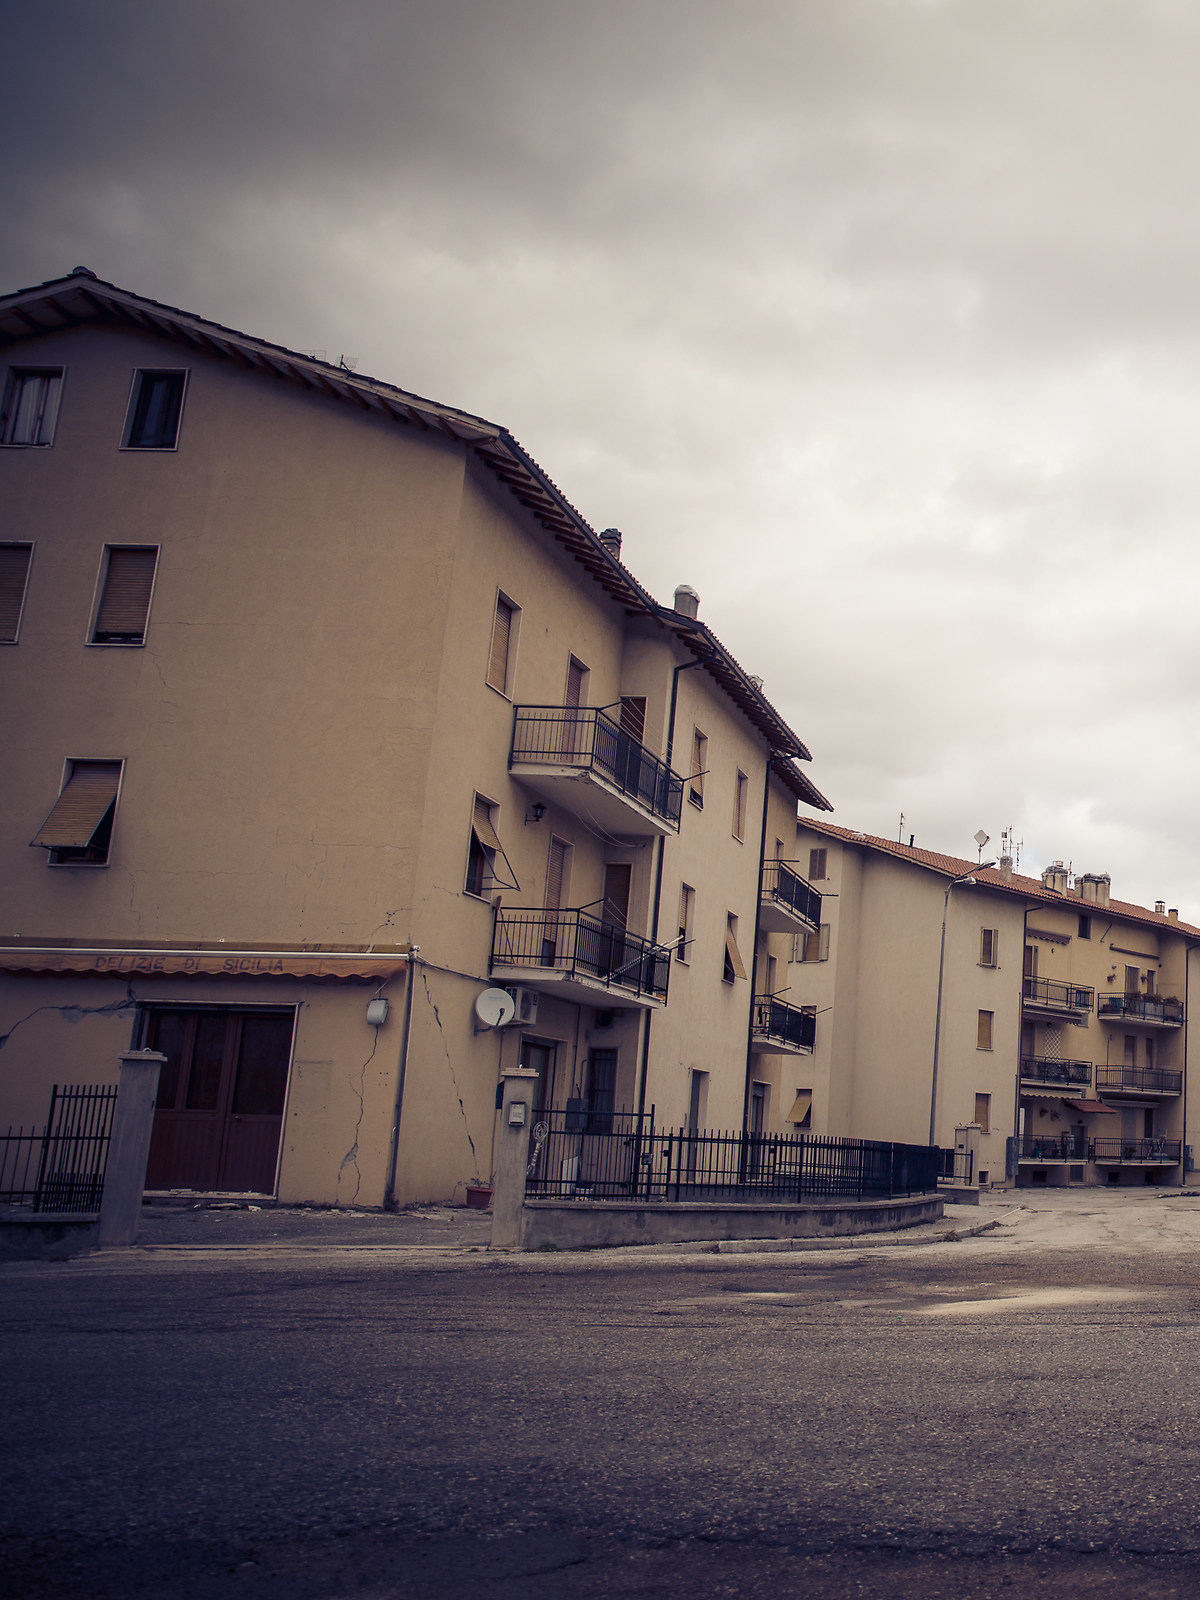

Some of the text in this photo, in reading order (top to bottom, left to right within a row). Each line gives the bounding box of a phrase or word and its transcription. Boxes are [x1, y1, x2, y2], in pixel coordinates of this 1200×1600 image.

[95, 956, 284, 972] DELIZIE DI SICILIA
